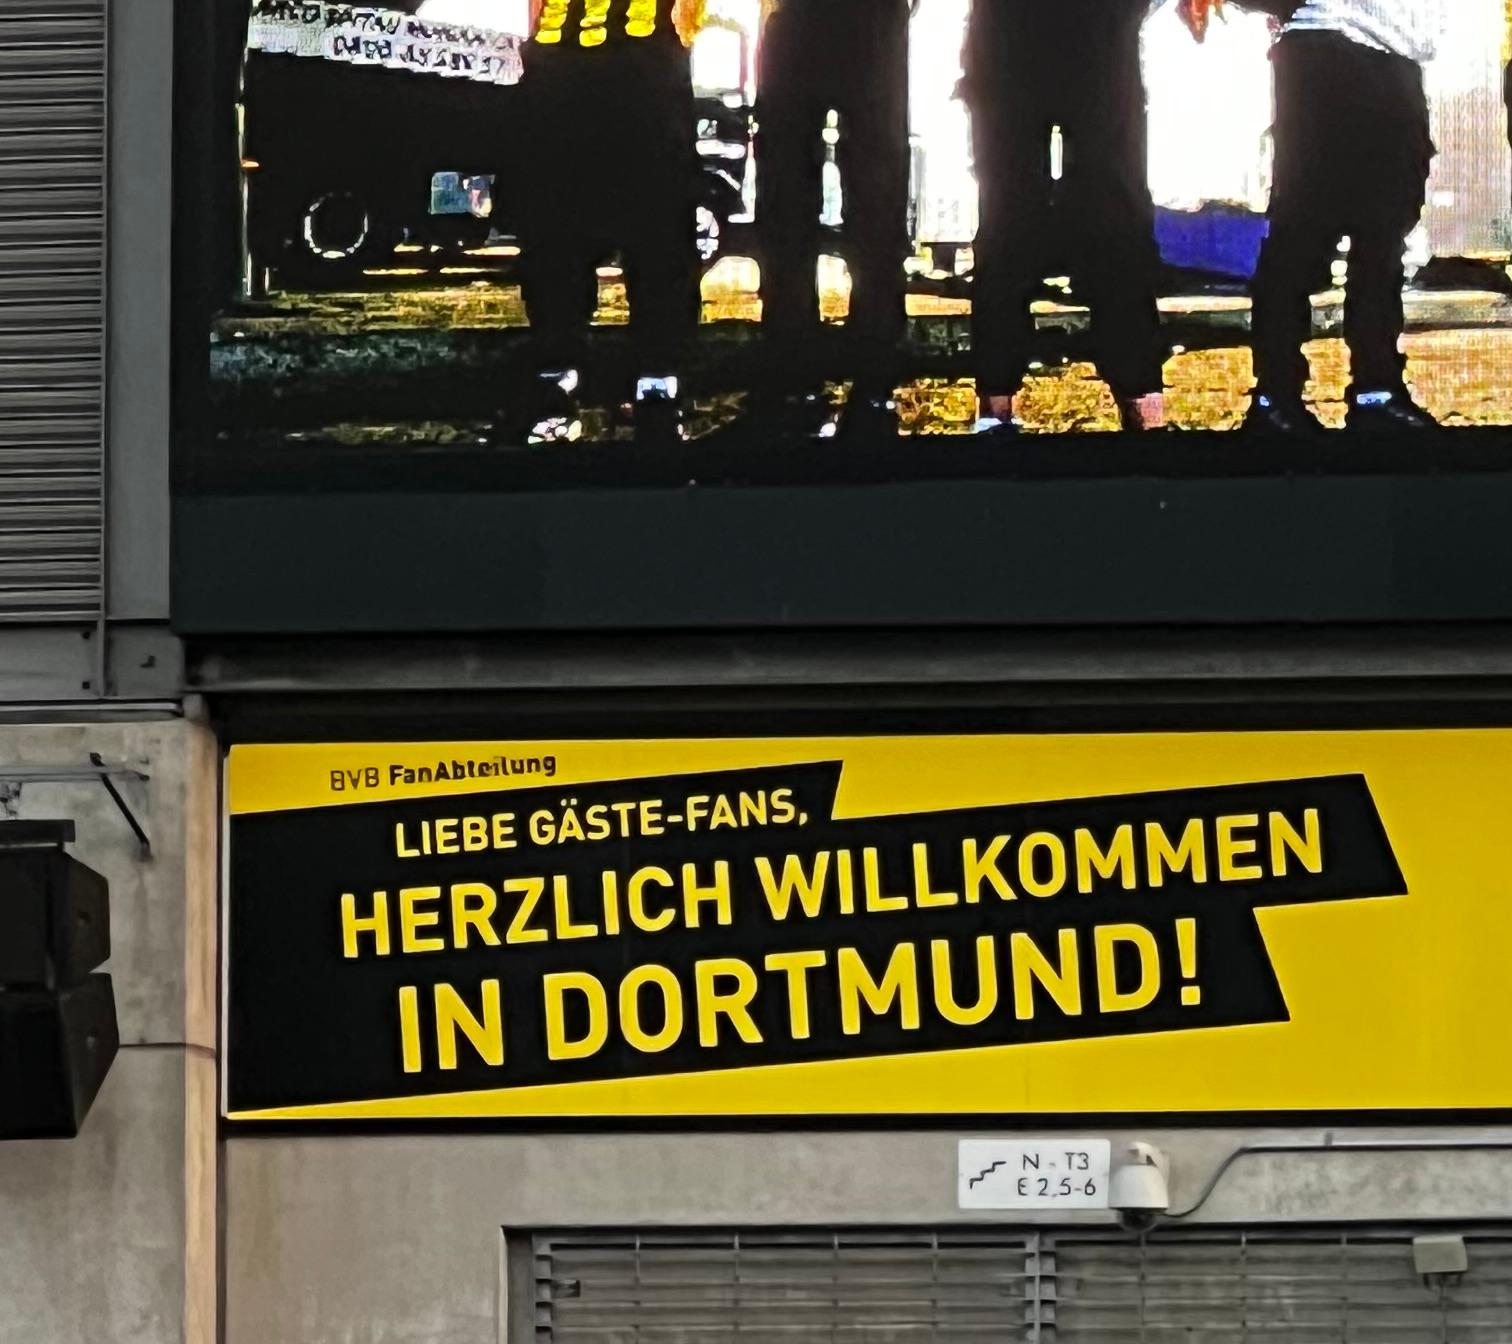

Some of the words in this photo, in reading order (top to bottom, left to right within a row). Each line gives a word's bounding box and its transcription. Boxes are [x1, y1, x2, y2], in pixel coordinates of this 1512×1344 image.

[330, 767, 379, 791] BVB
[389, 756, 556, 786] FanAbteilung
[396, 812, 517, 858] LIEBE
[529, 788, 808, 847] GÄSTE-FANS,
[340, 860, 732, 958] HERZLICH
[755, 808, 1324, 920] WILLKOMMEN
[398, 978, 504, 1073] IN
[543, 917, 1202, 1061] DORTMUND!
[1017, 1177, 1028, 1196] E
[1023, 1154, 1039, 1170] N
[1065, 1152, 1089, 1170] T3
